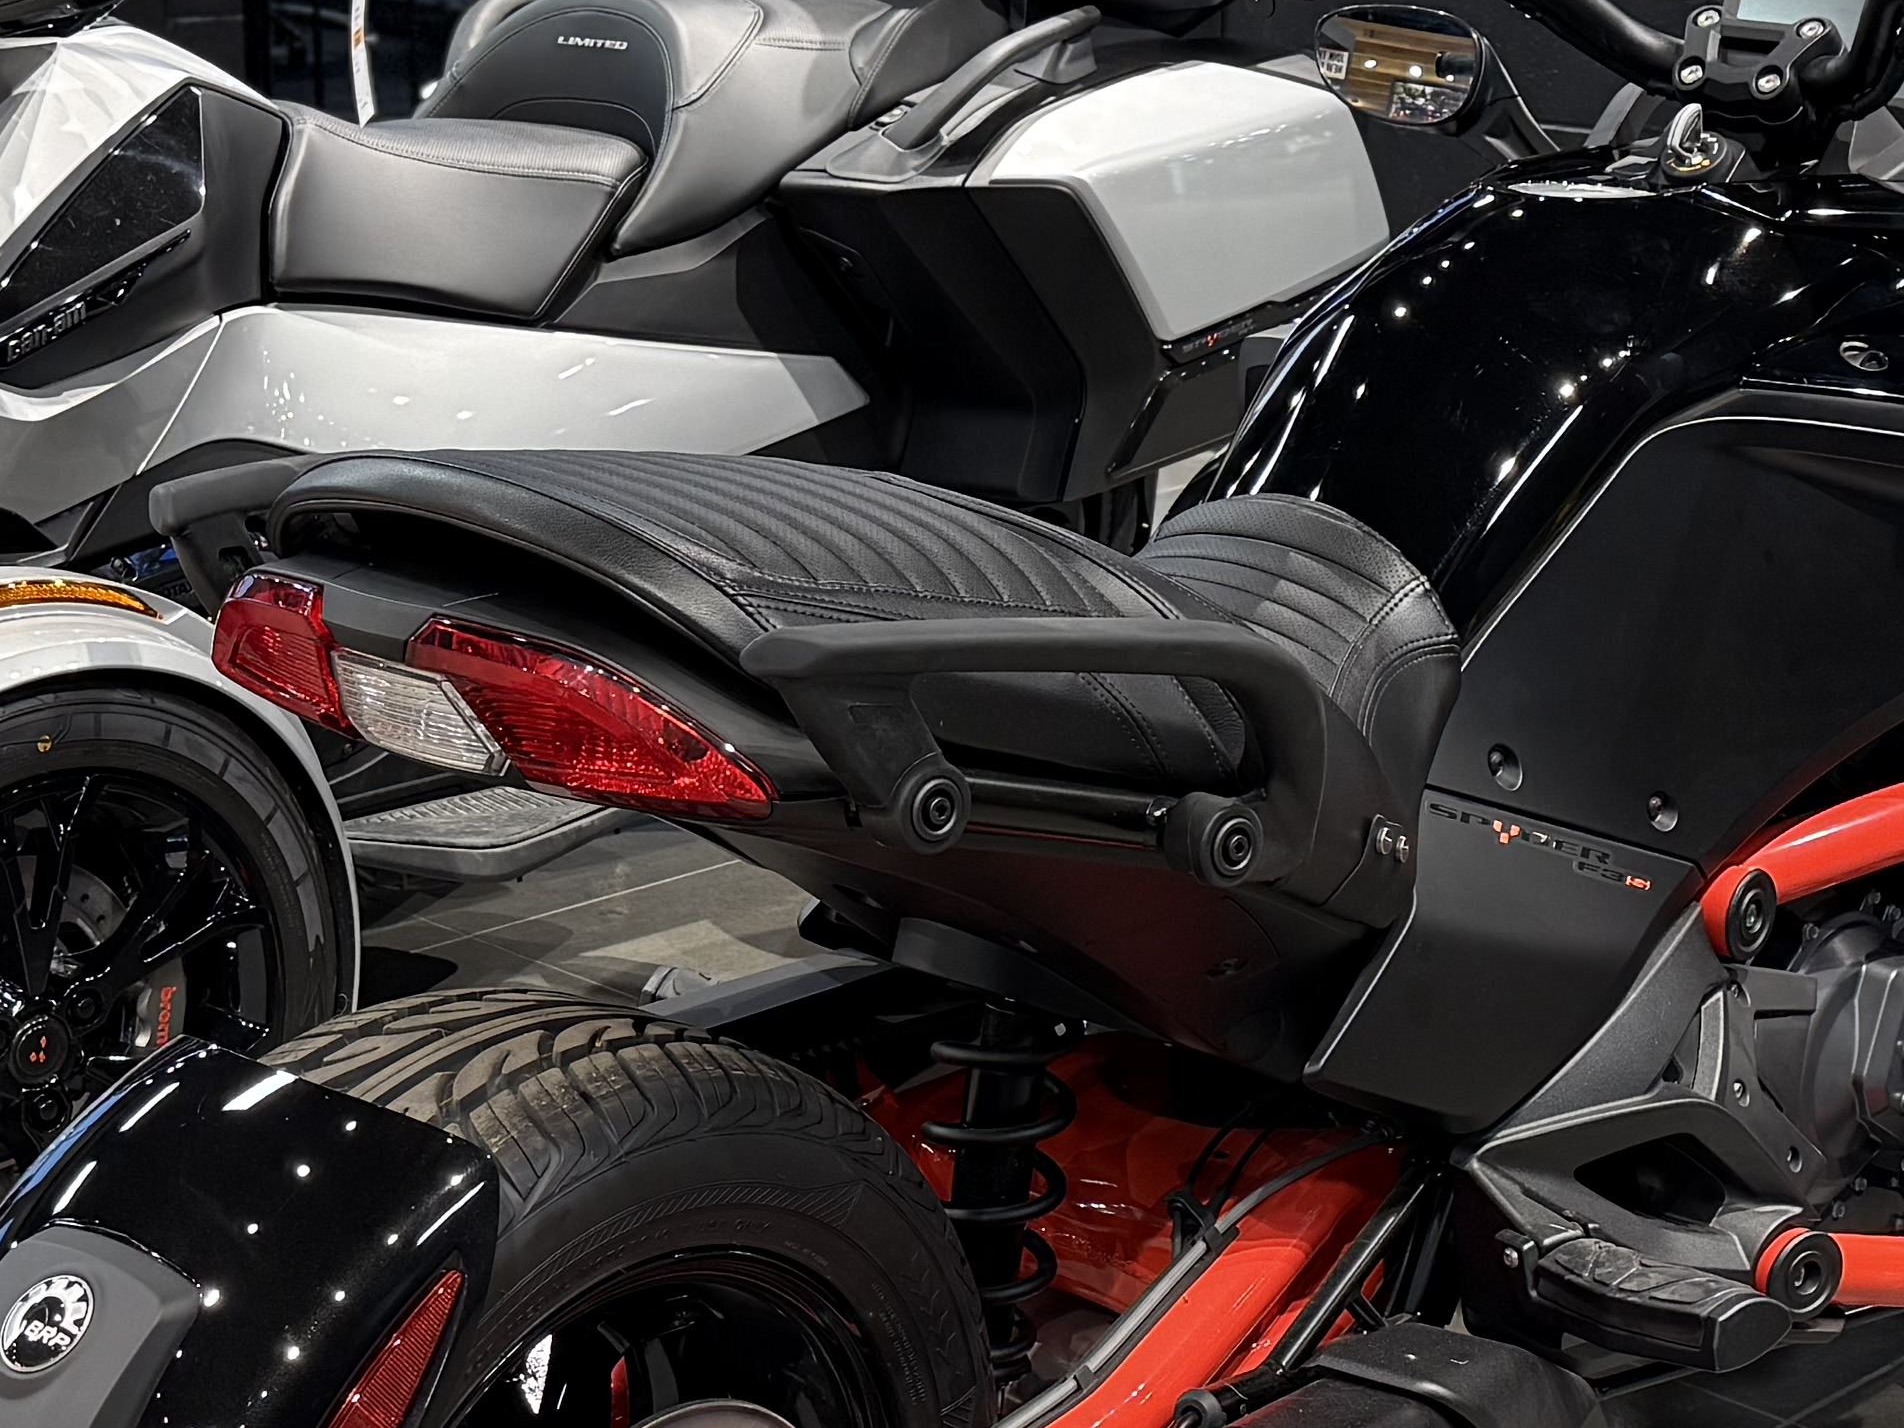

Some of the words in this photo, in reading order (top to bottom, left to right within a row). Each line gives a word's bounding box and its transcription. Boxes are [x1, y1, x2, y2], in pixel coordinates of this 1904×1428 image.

[557, 35, 628, 50] LIMITED
[1429, 802, 1611, 866] SPYDER
[157, 986, 176, 1046] brem
[23, 1319, 72, 1347] BRP
